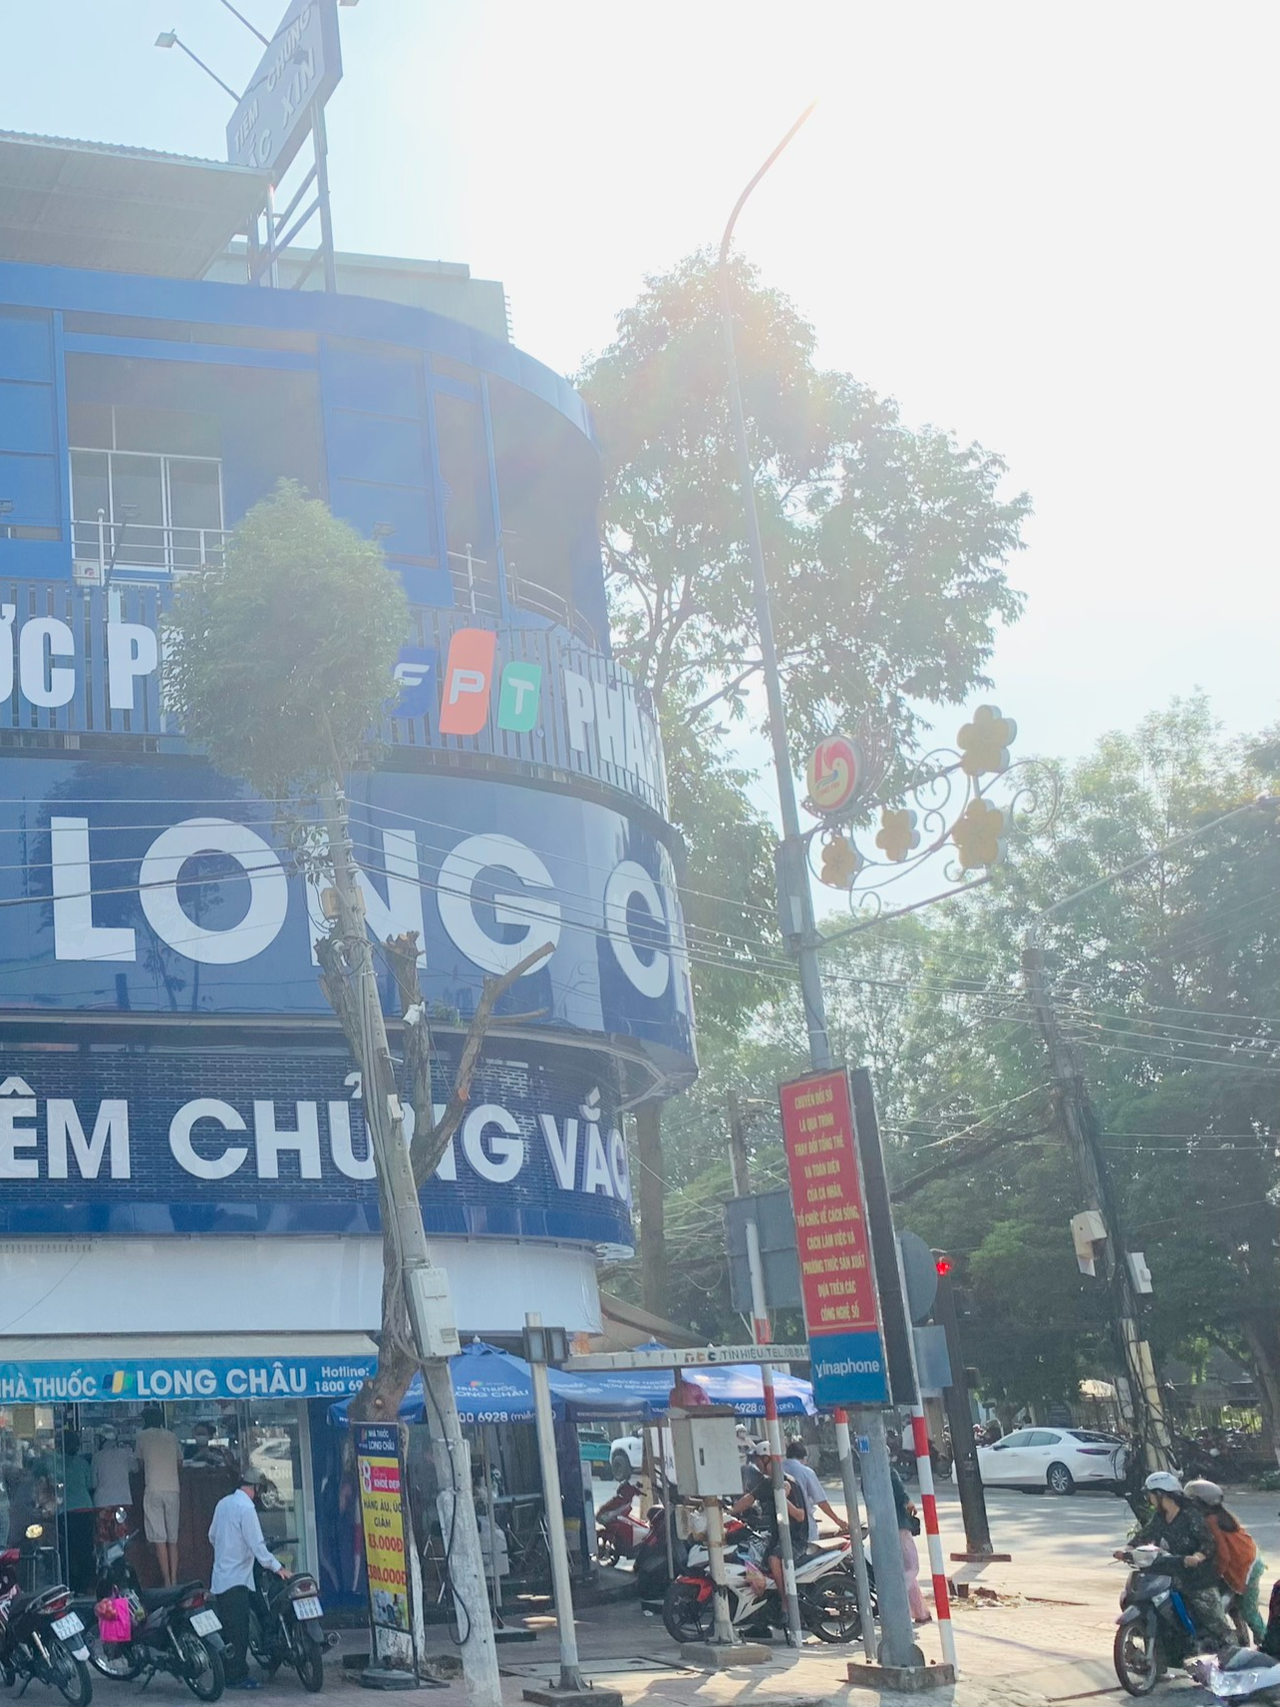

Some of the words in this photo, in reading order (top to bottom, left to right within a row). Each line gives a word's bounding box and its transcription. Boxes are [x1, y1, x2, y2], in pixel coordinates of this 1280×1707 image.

[282, 47, 315, 129] XIN
[390, 652, 538, 722] FPT
[51, 817, 561, 977] LONG
[33, 1368, 97, 1398] THUỐC
[136, 1369, 218, 1396] LONG
[226, 1361, 307, 1395] CHÂU
[321, 1366, 370, 1379] Hotline:
[314, 1380, 345, 1393] 1800
[348, 1380, 364, 1392] 69
[491, 1389, 529, 1398] CHÂU
[478, 1411, 508, 1423] 6928
[374, 1514, 391, 1528] GIẢM
